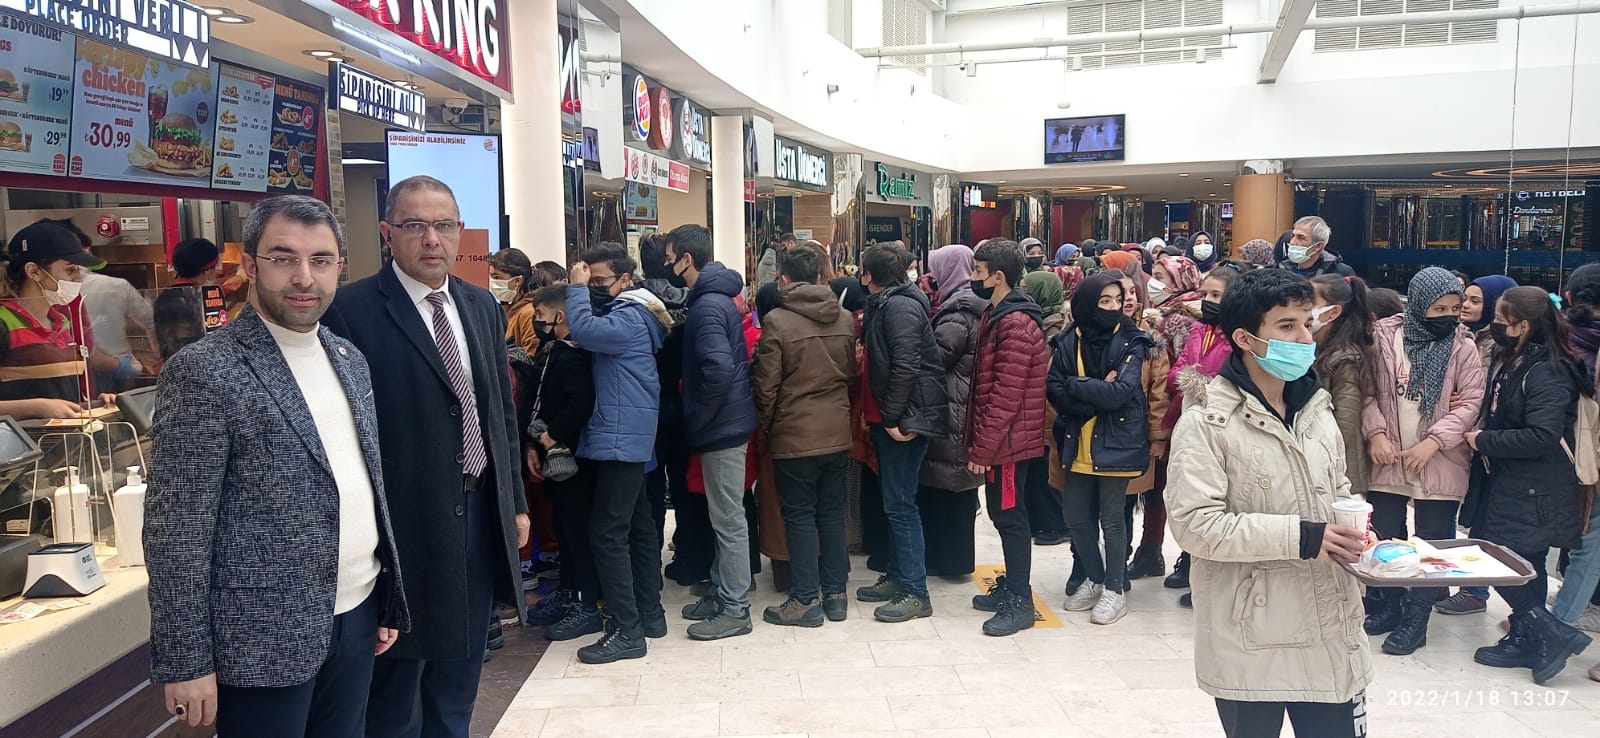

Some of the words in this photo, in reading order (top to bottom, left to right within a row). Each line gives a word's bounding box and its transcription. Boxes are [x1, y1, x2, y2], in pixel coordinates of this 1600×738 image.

[82, 13, 128, 44] ORDER
[82, 63, 146, 98] chicken
[775, 139, 797, 181] USTA
[877, 162, 916, 201] Ramiz
